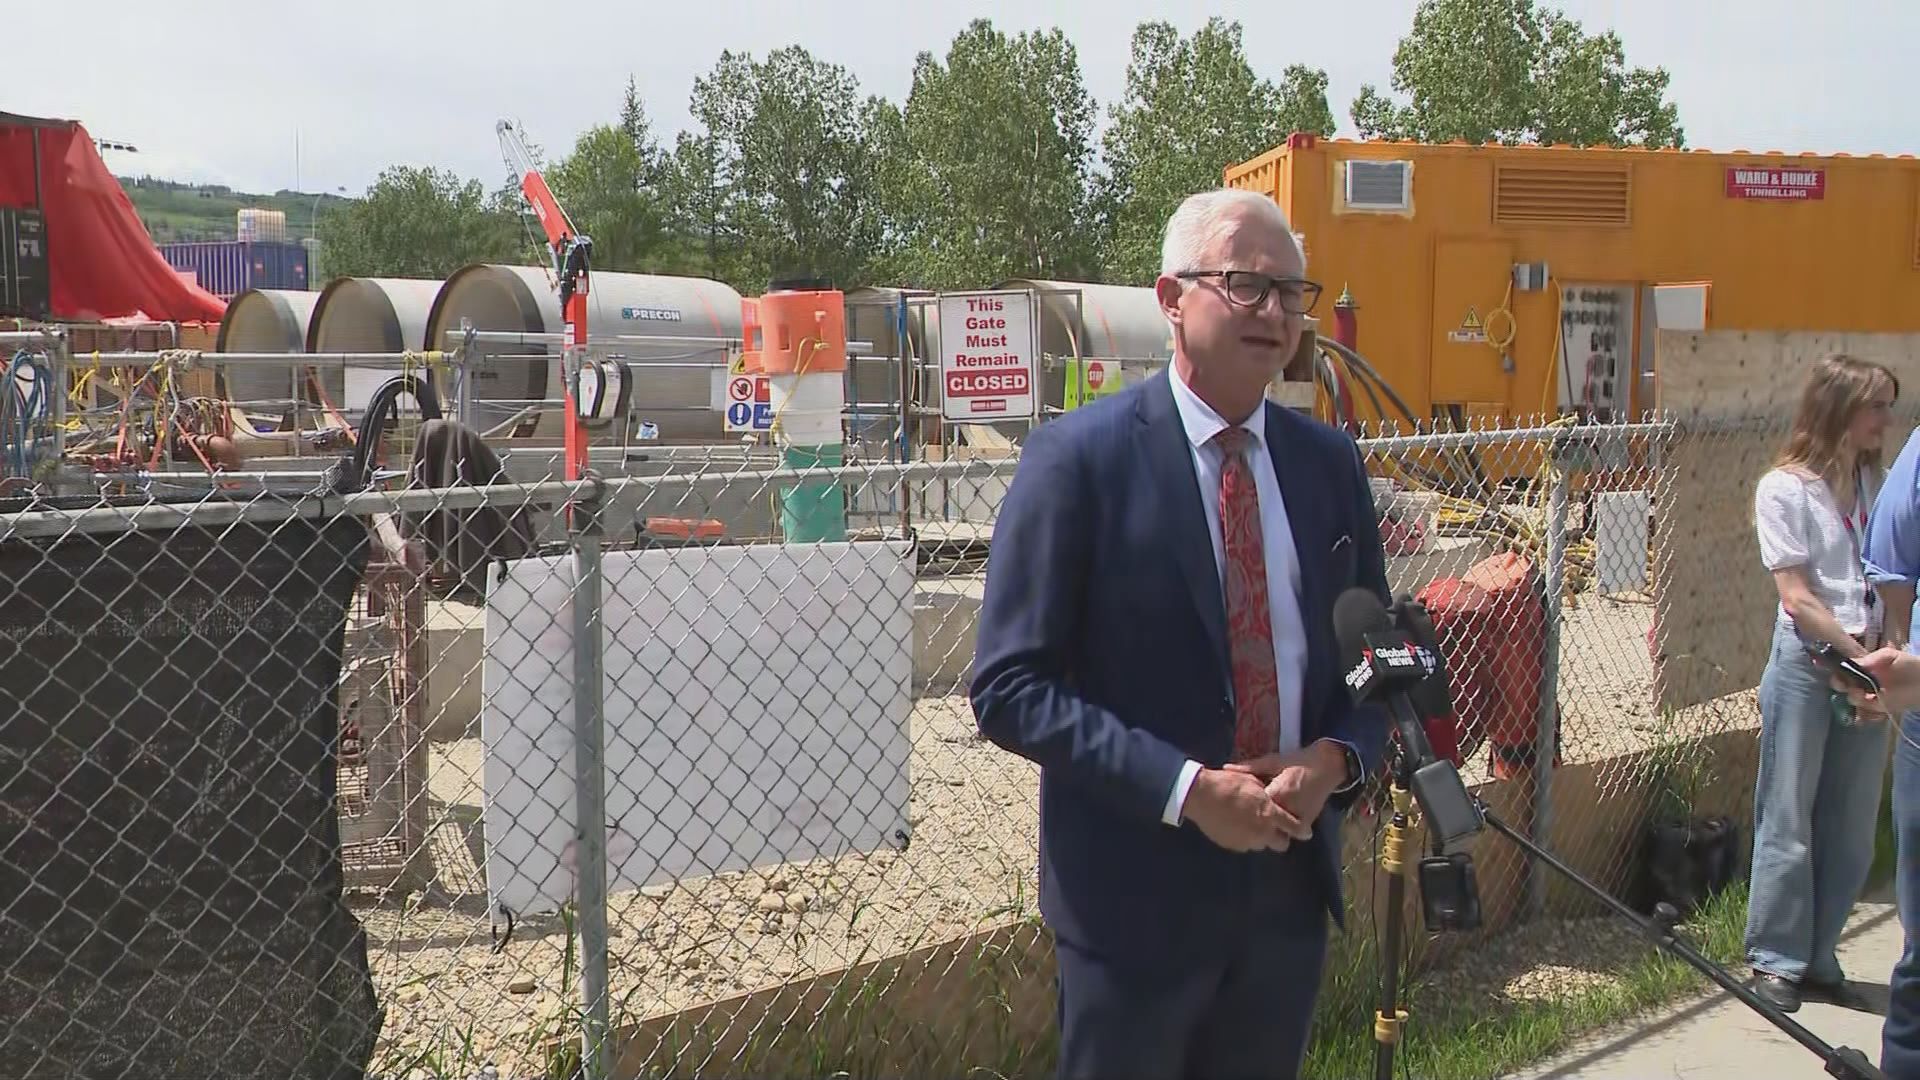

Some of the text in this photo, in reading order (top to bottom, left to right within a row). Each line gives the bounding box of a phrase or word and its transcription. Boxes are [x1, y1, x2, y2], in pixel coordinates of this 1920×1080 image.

[1735, 170, 1818, 186] WARD & BURKE
[1744, 188, 1807, 198] TUNNELLING
[966, 299, 1004, 312] This
[631, 308, 680, 321] PRECON
[966, 317, 1006, 330] Gate
[966, 334, 1007, 348] Must
[956, 353, 1019, 367] Remain
[949, 374, 1027, 391] CLOSED
[1089, 371, 1103, 381] STOP
[1375, 647, 1411, 658] Global
[1387, 657, 1414, 667] NEWS
[1345, 657, 1370, 684] Global
[1354, 668, 1373, 690] NEWS
